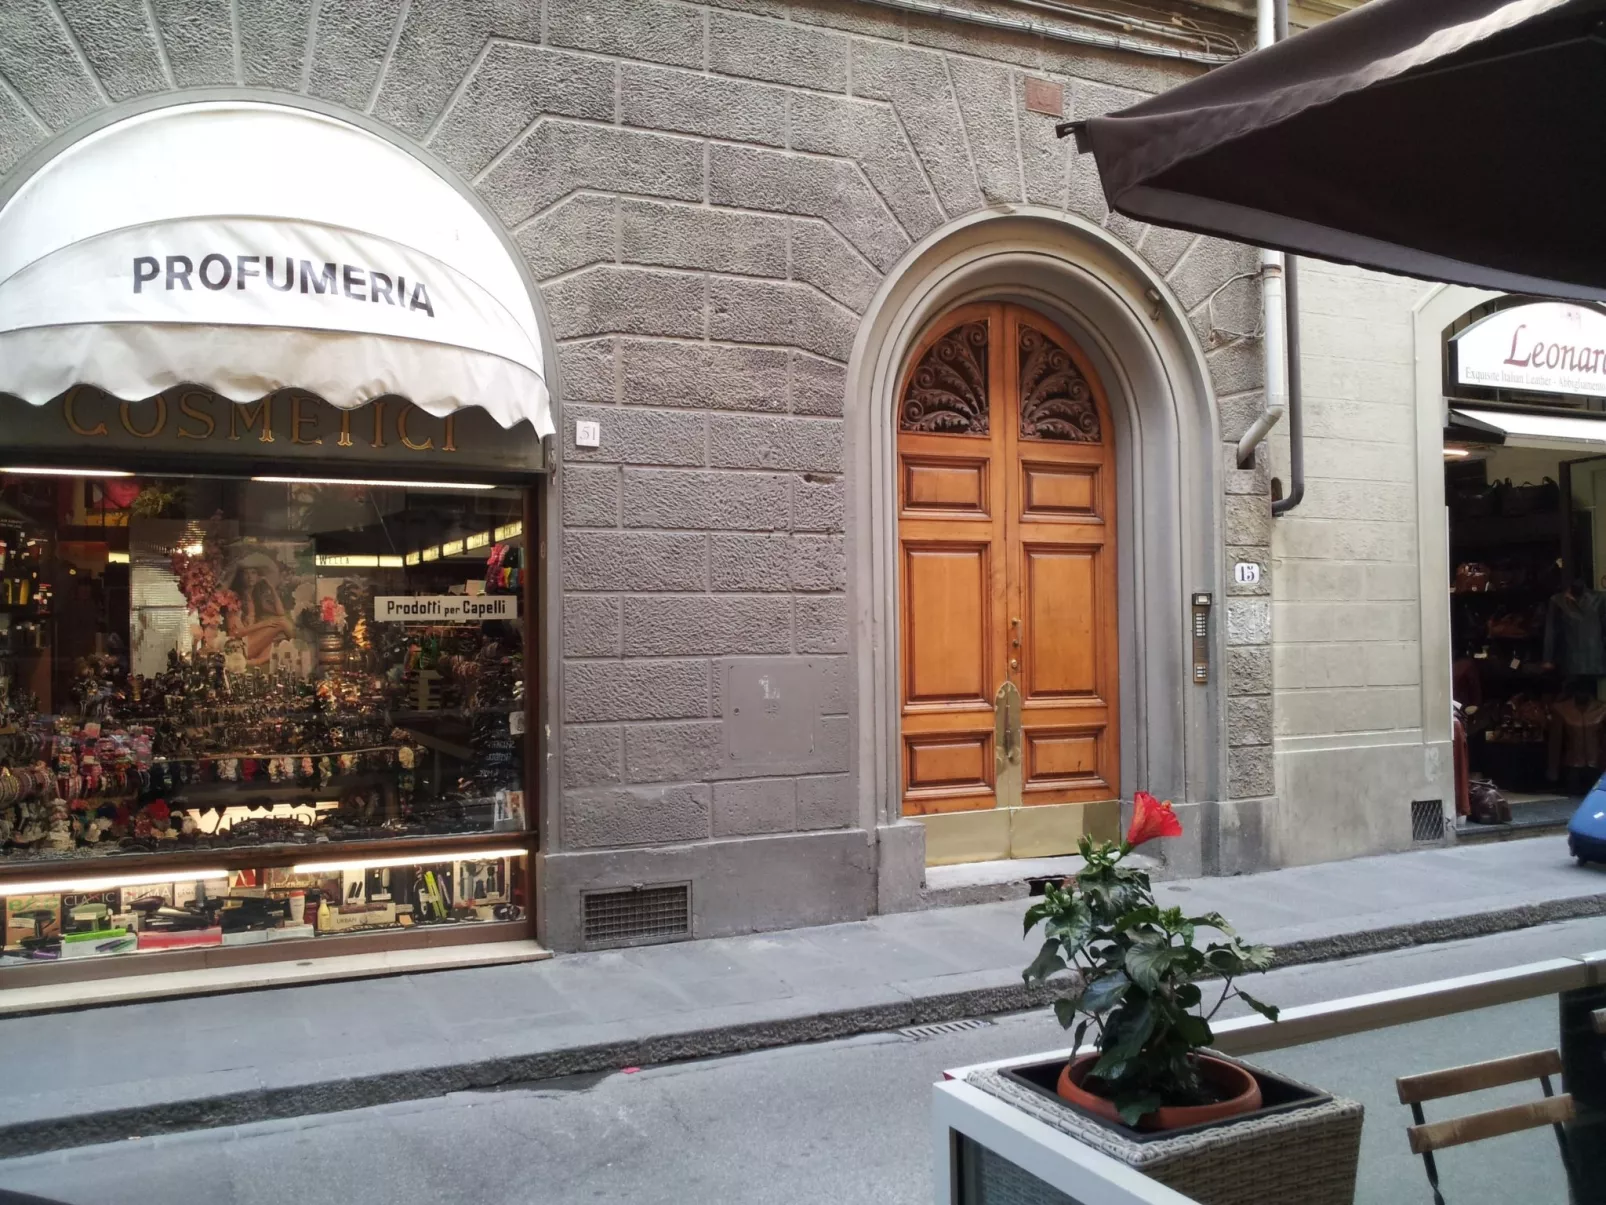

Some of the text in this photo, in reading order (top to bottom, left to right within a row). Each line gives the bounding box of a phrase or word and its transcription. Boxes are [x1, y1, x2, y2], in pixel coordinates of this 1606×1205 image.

[133, 253, 435, 318] PROFUMERIA
[1503, 324, 1606, 375] Leonar
[1465, 366, 1500, 383] Exquisite
[1501, 369, 1524, 384] Italian
[1526, 372, 1552, 386] Leather
[63, 385, 457, 452] COSMETICI
[1240, 565, 1255, 581] 15
[387, 600, 506, 618] Prodotti per Capelli
